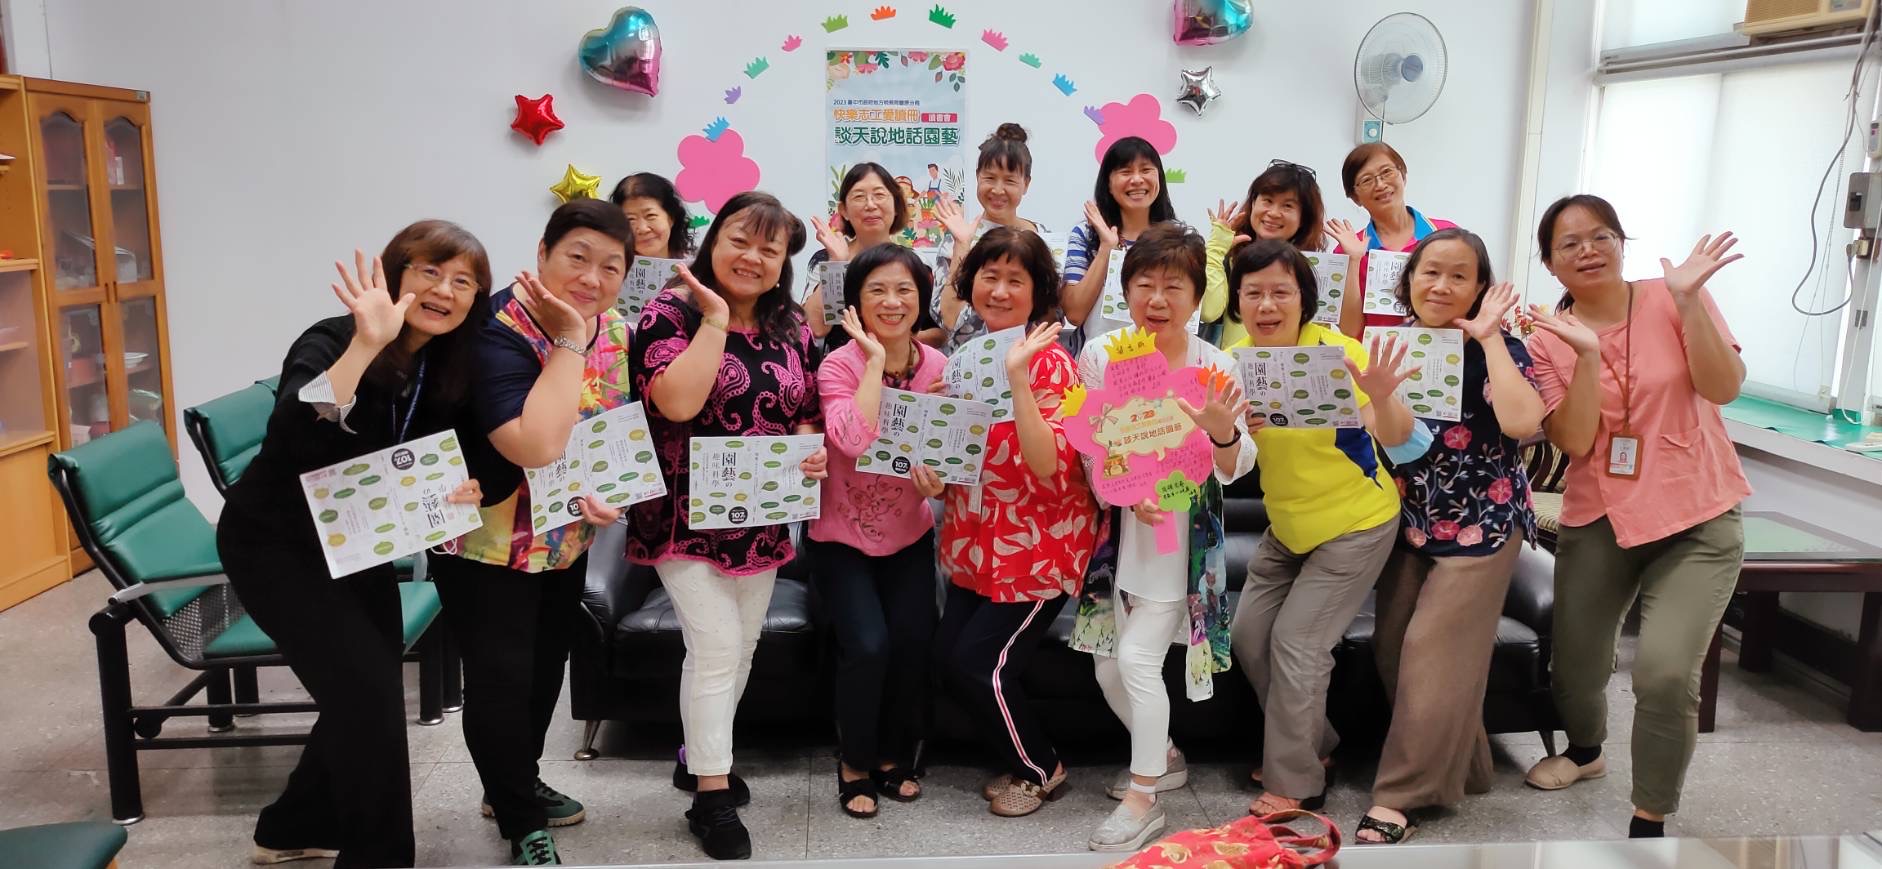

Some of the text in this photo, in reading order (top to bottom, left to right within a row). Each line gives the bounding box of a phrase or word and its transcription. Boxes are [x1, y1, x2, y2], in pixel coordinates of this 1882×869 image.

[834, 126, 959, 146] 談天說地話園藝
